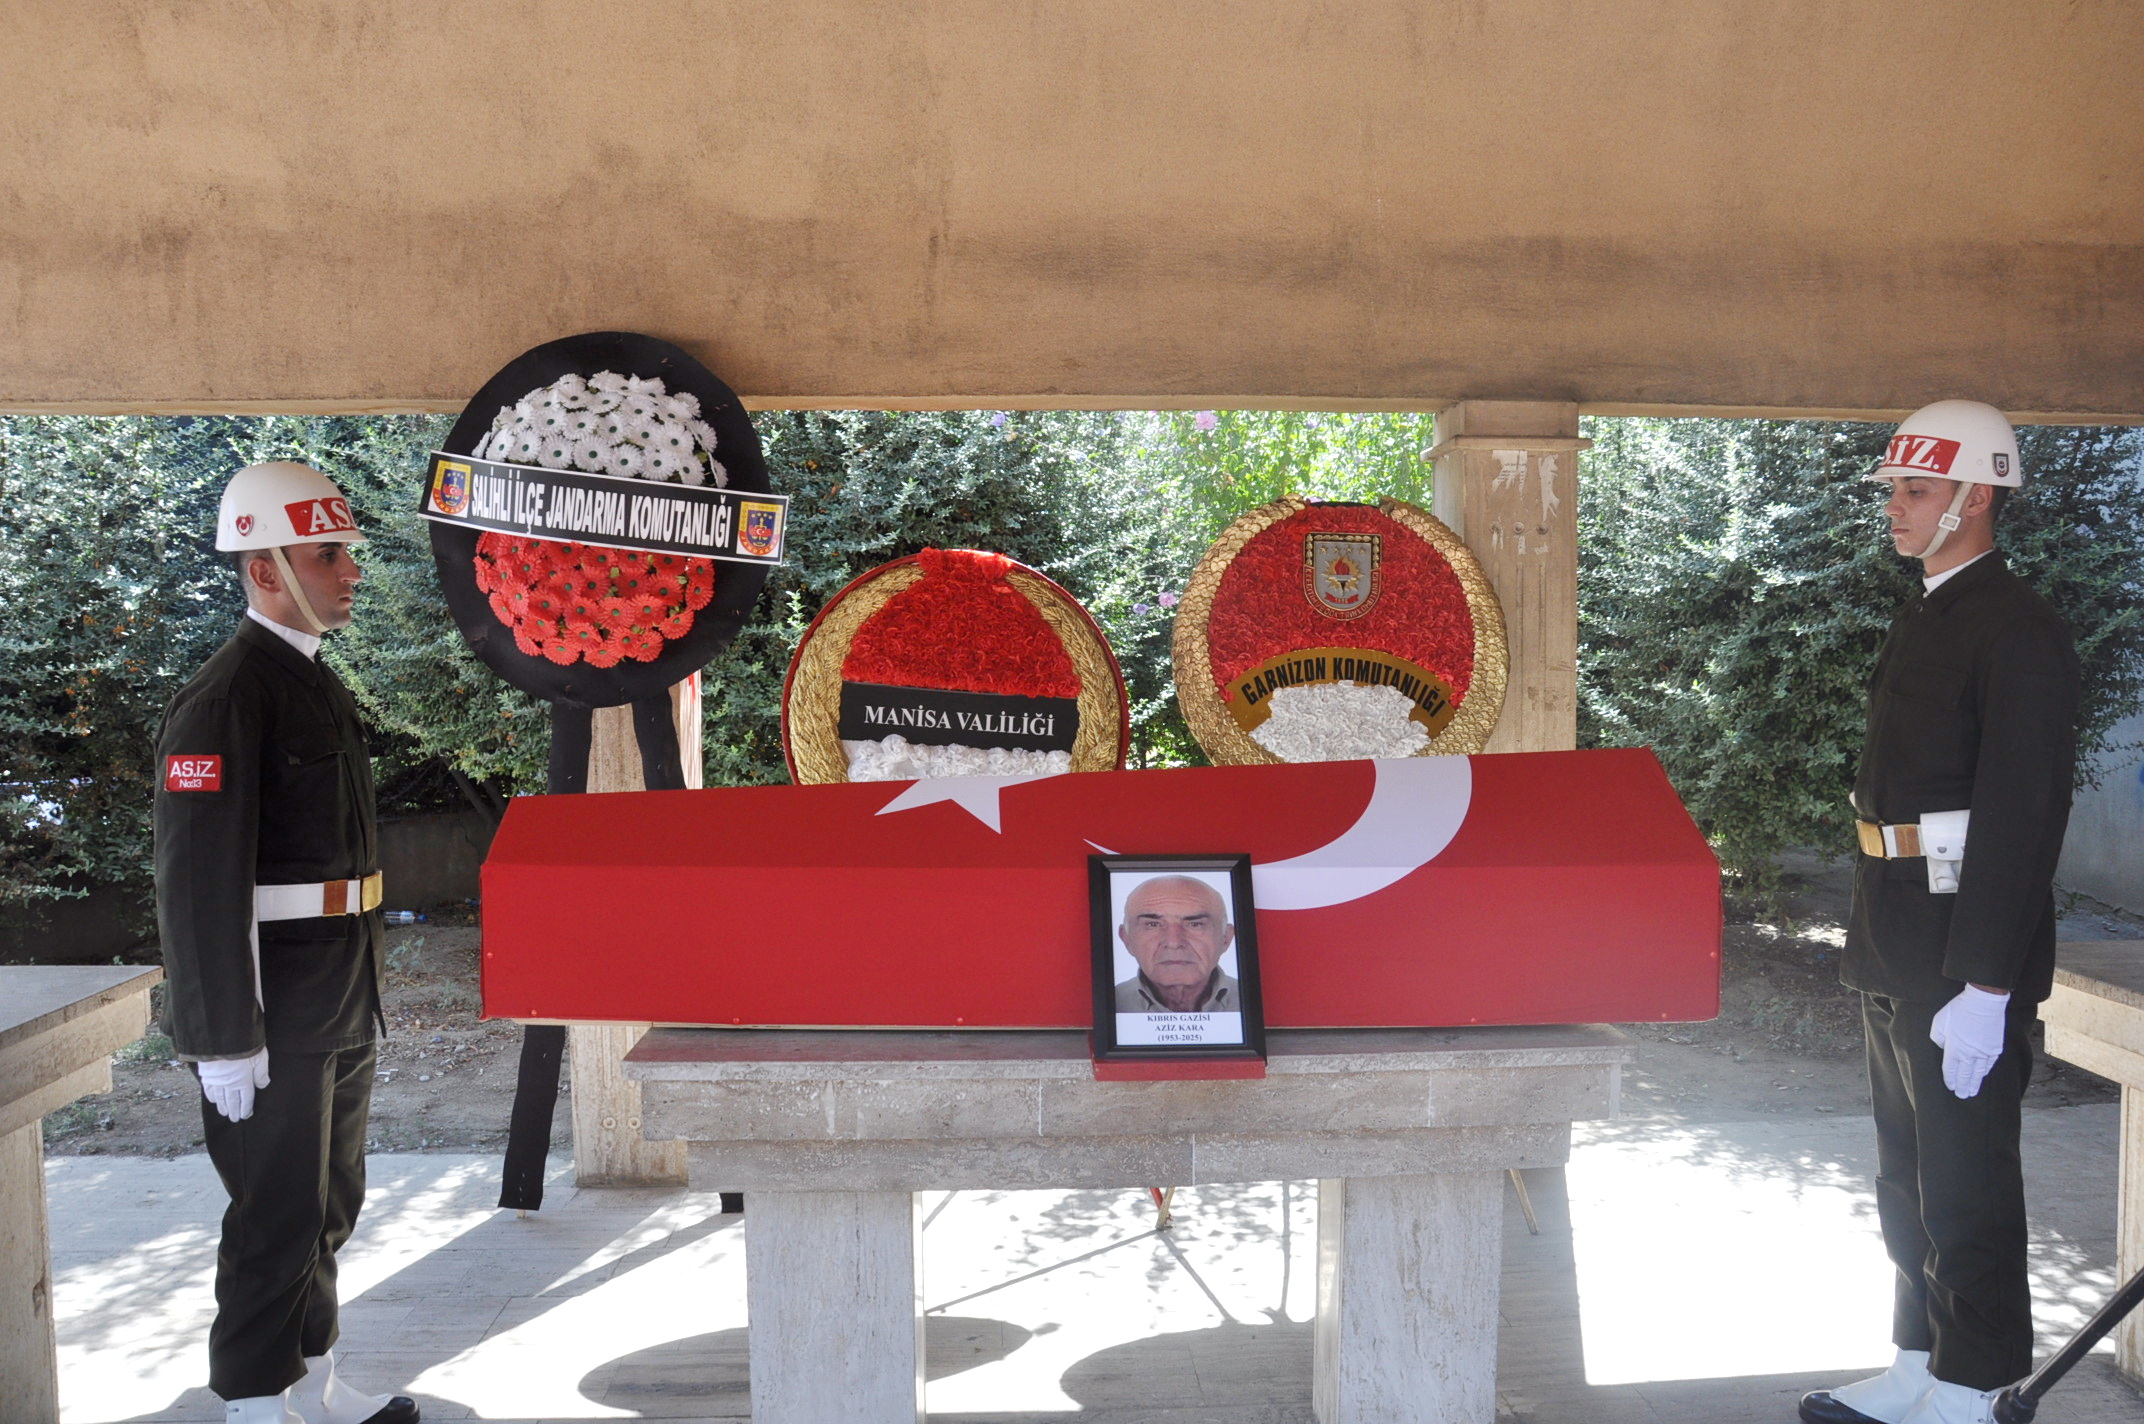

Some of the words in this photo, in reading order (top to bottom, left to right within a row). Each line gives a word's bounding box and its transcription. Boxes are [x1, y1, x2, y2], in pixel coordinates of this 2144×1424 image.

[471, 466, 512, 521] SALİHLİ
[513, 471, 543, 534] İLÇE
[546, 484, 625, 537] JANDARMA
[628, 494, 733, 549] KOMUTANLIĞI
[1241, 657, 1326, 706] GARNİZON
[1333, 657, 1446, 718] KOMUTANLIĞI
[864, 705, 951, 729] MANİSA
[956, 711, 1055, 736] VALİLİĞİ
[1180, 1013, 1211, 1022] GAZİSİ
[1155, 1024, 1177, 1032] AZİZ
[1178, 1024, 1204, 1032] KARA
[1157, 1034, 1202, 1042] (1953-2025)
